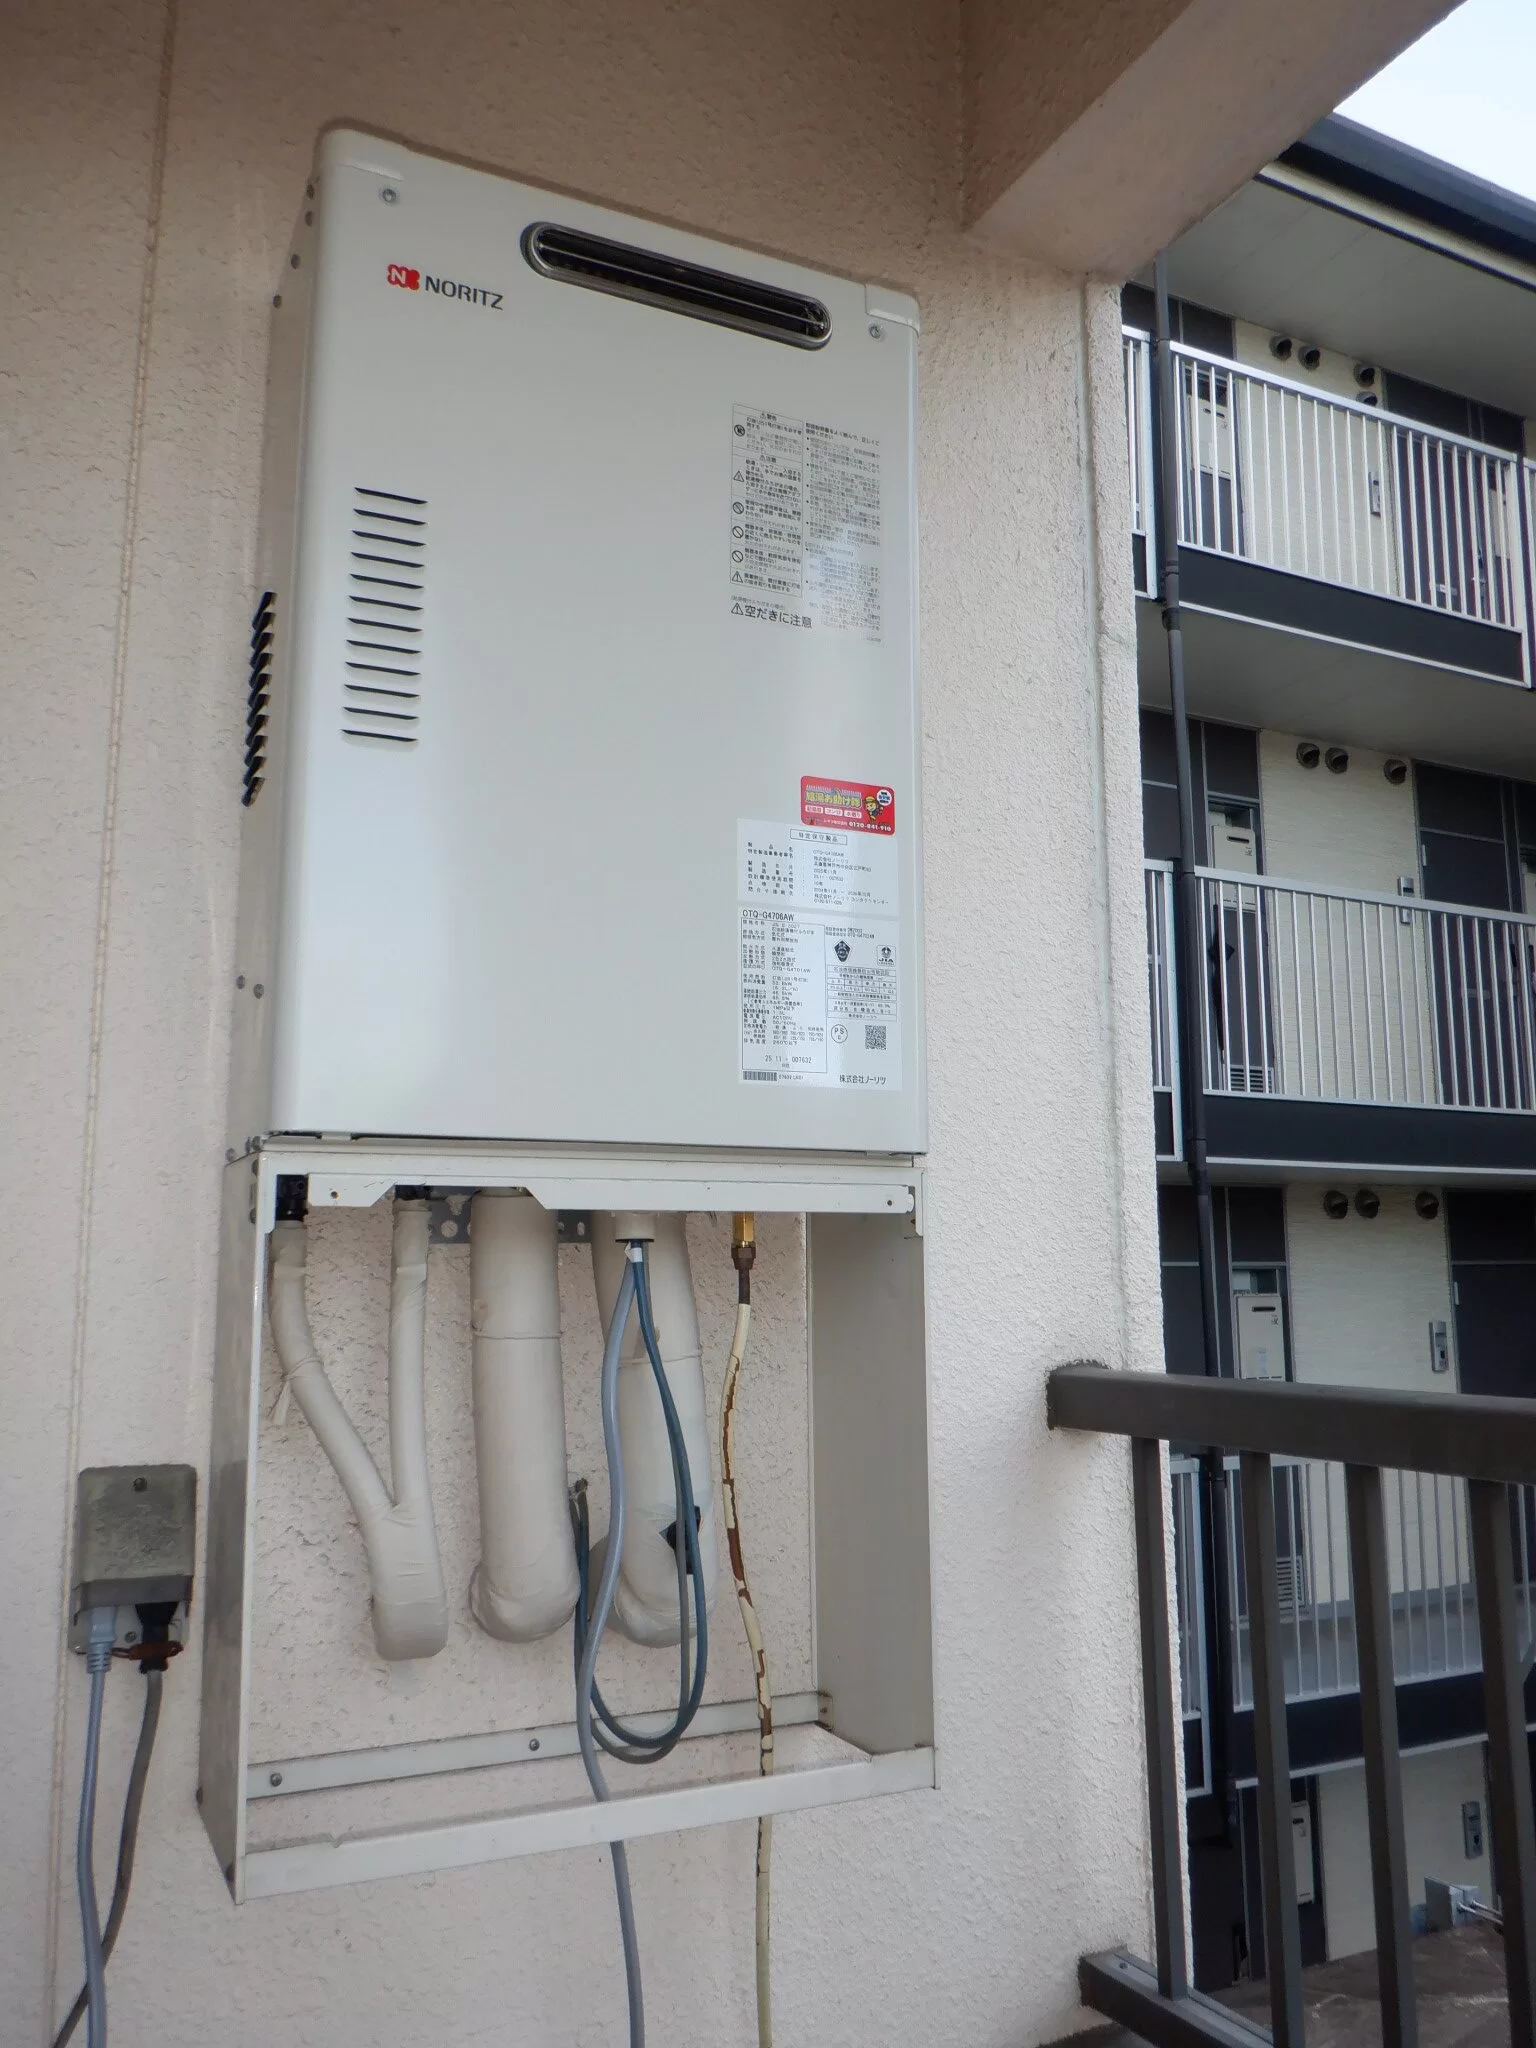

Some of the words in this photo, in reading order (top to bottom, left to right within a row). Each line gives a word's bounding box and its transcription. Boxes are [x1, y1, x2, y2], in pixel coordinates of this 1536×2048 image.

[425, 275, 503, 311] NORITZ
[744, 604, 812, 629] 空だきに注意
[742, 909, 795, 922] OTQ-G4706AW
[839, 1074, 887, 1085] 株式会社ノーリツ
